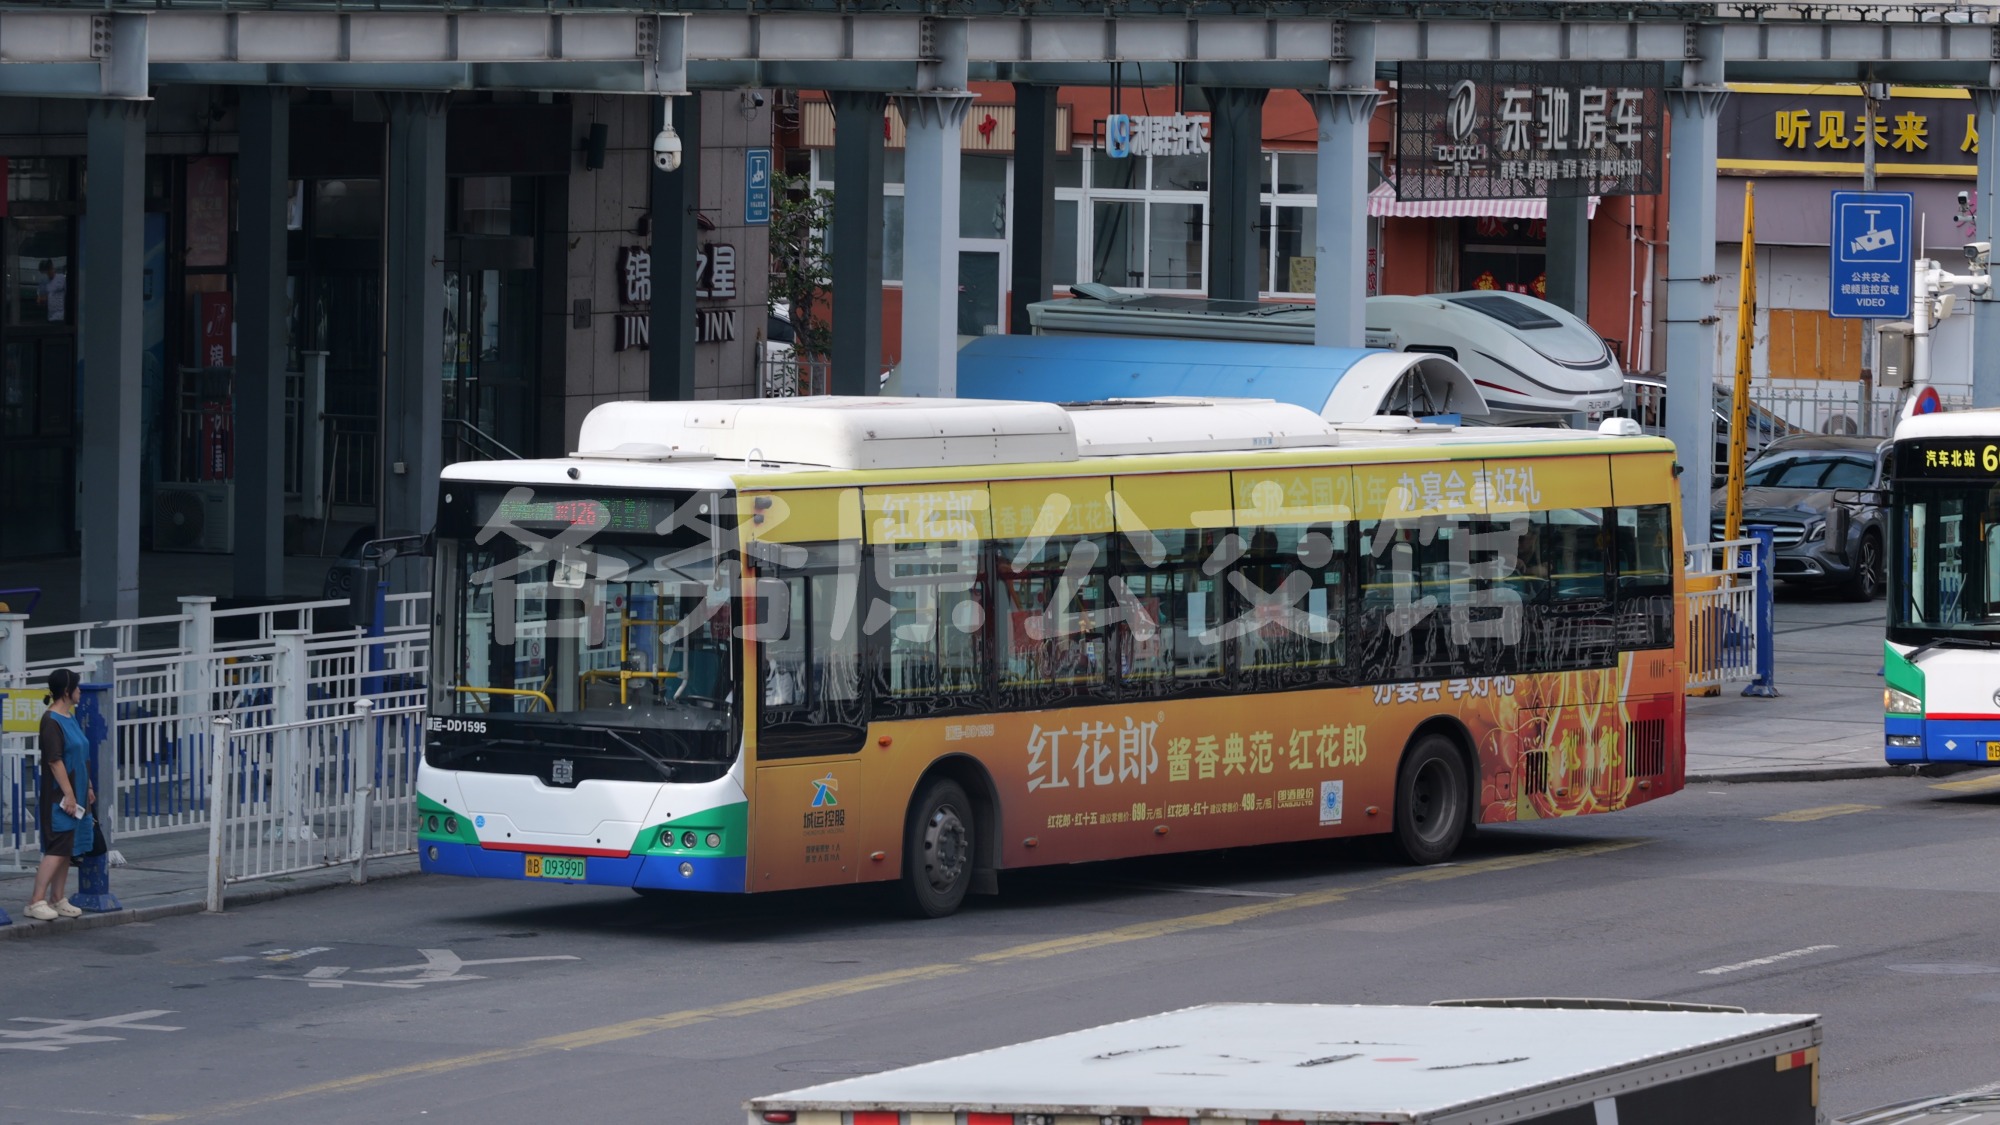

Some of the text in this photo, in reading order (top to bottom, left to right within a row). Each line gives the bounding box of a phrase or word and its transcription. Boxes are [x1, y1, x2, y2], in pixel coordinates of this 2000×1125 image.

[1129, 112, 1210, 155] 利群洗衣
[1501, 86, 1644, 151] 东驰房车
[1775, 108, 1929, 153] 听见未来
[1840, 283, 1900, 295] 视频监控区域
[1851, 271, 1890, 283] 公共安全
[1856, 297, 1886, 307] VIDEO
[1926, 444, 2000, 472] 汽车北站 6
[1397, 469, 1467, 512] 办宴会
[882, 492, 976, 541] 红花郎
[1027, 714, 1367, 793] 红花郎 酱香典范·红花郎
[802, 809, 846, 830] 城运控股
[544, 859, 584, 877] 09399D
